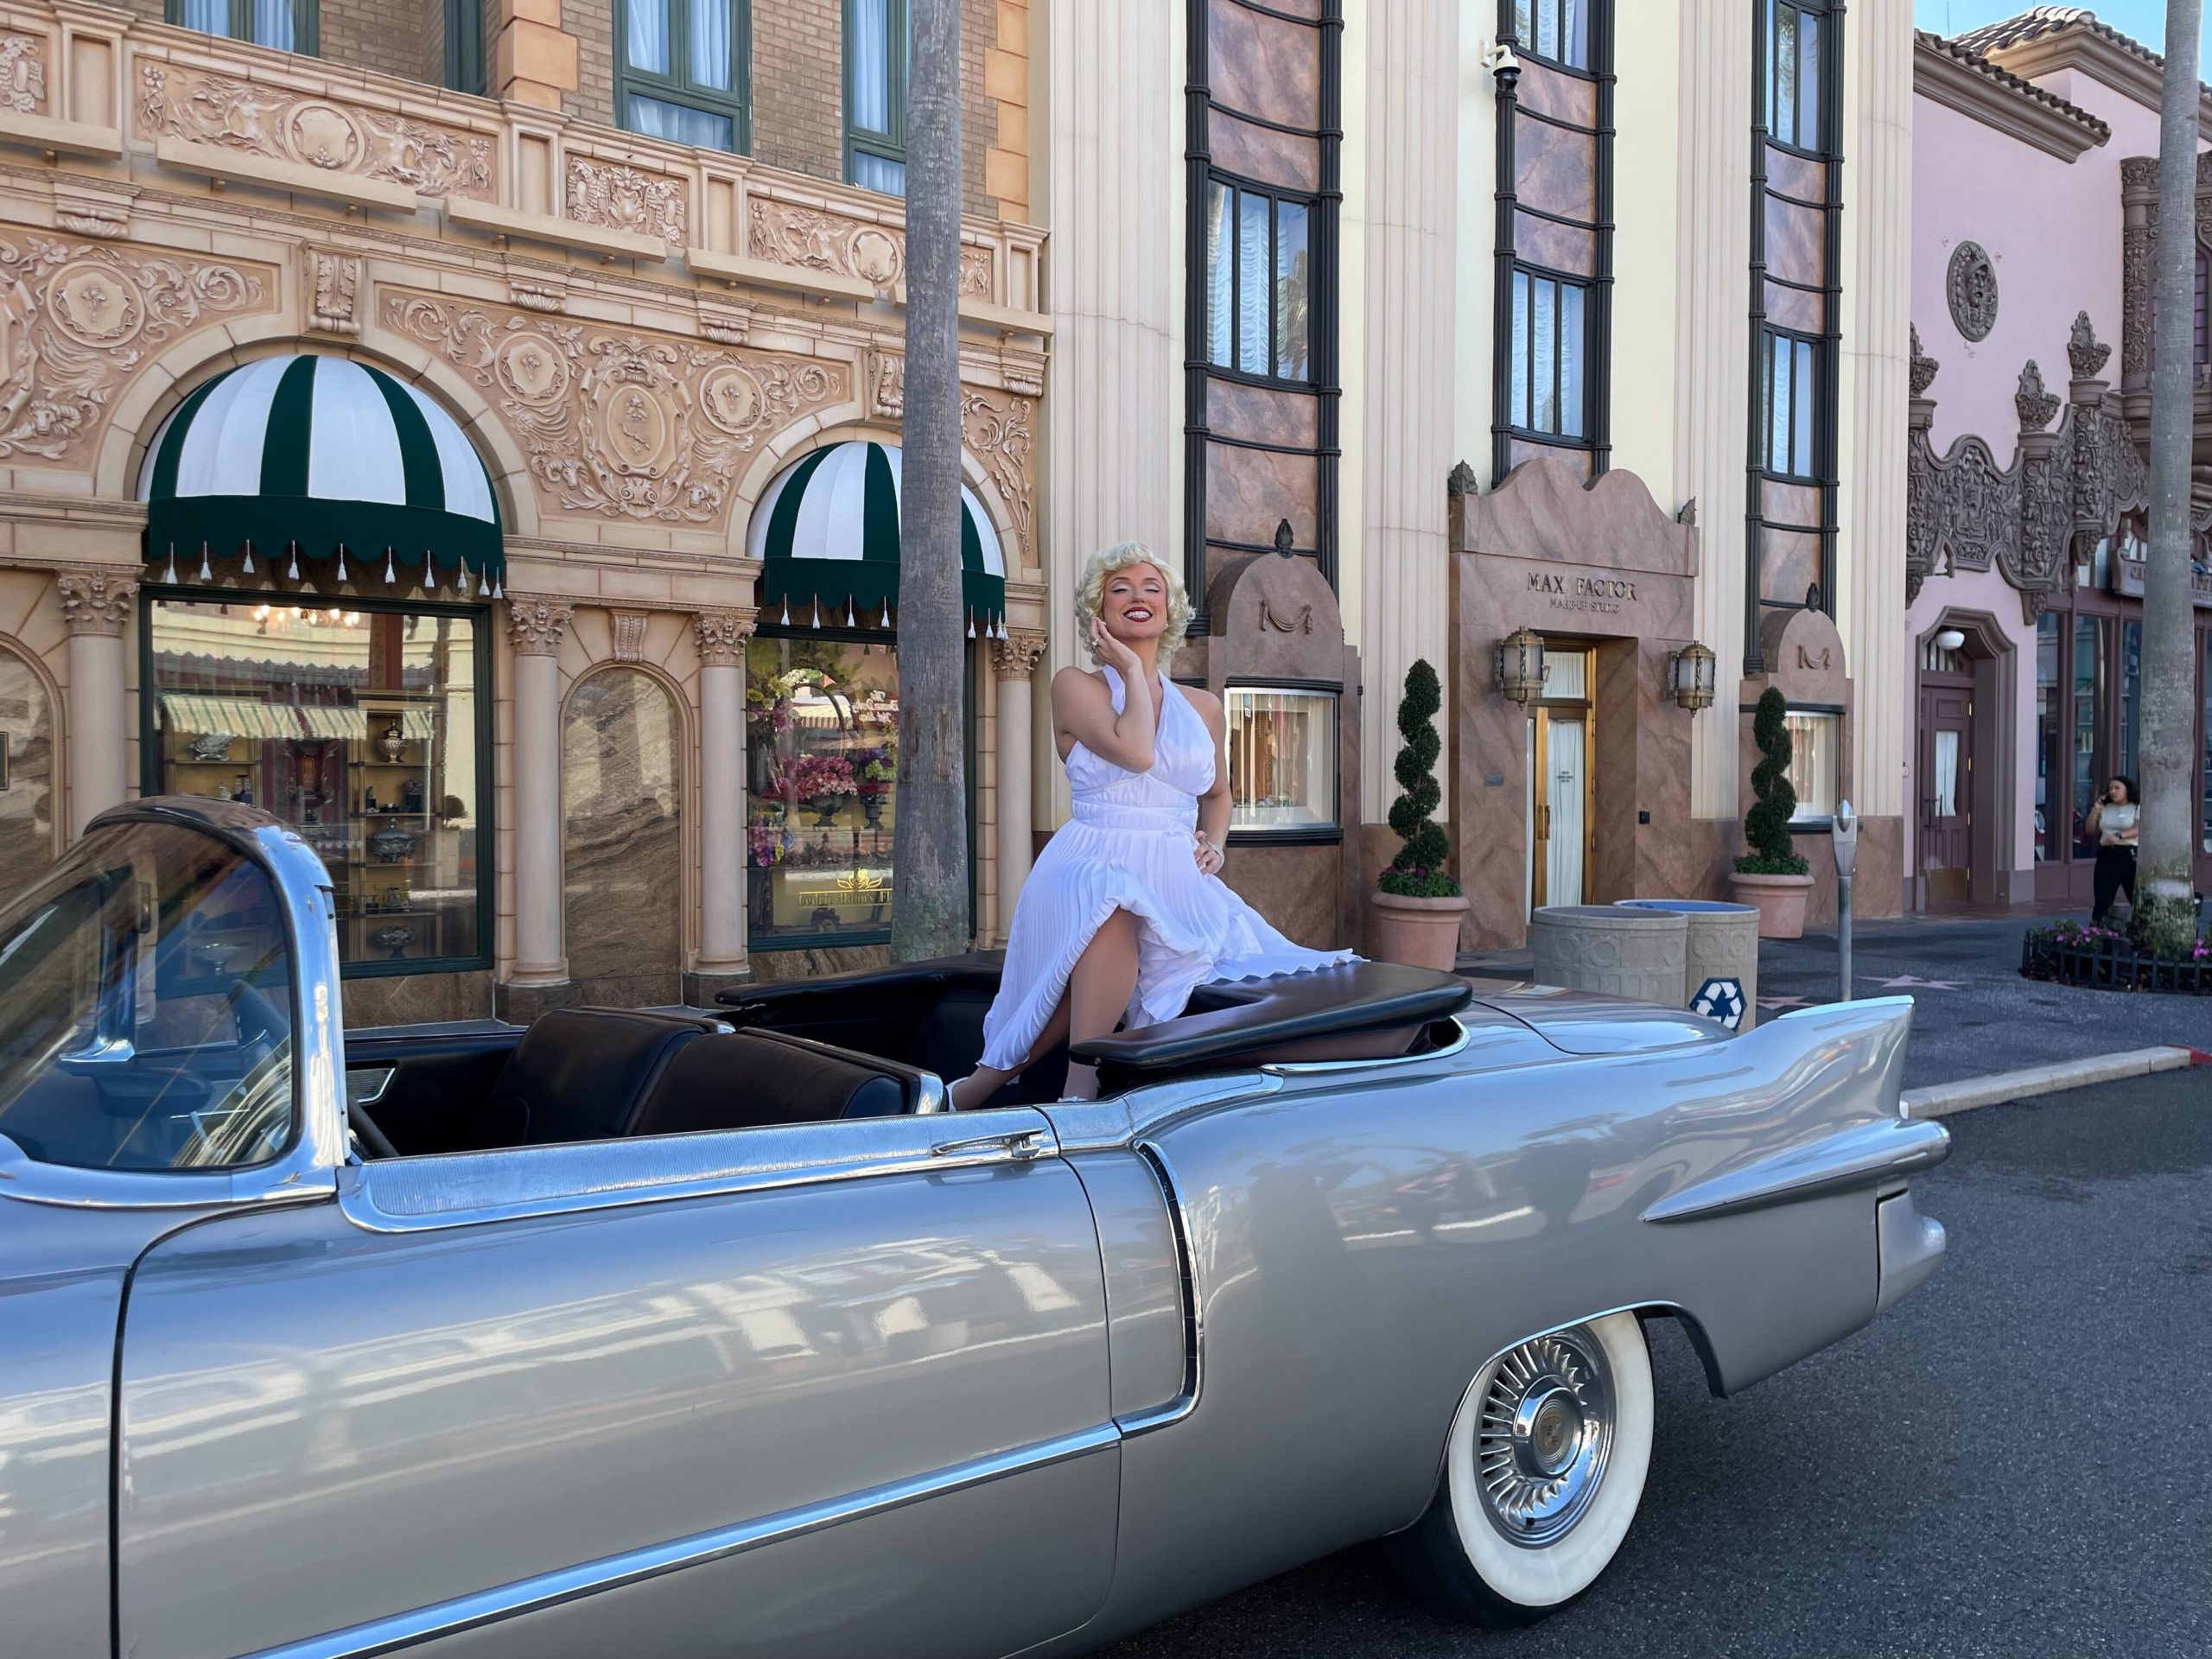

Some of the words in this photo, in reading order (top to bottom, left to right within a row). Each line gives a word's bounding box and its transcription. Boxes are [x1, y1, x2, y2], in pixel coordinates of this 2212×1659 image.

[1528, 573, 1564, 594] MAX
[1576, 578, 1637, 601] FACTOR
[1550, 599, 1586, 610] MAKE-UP
[1591, 602, 1618, 613] STUDIO
